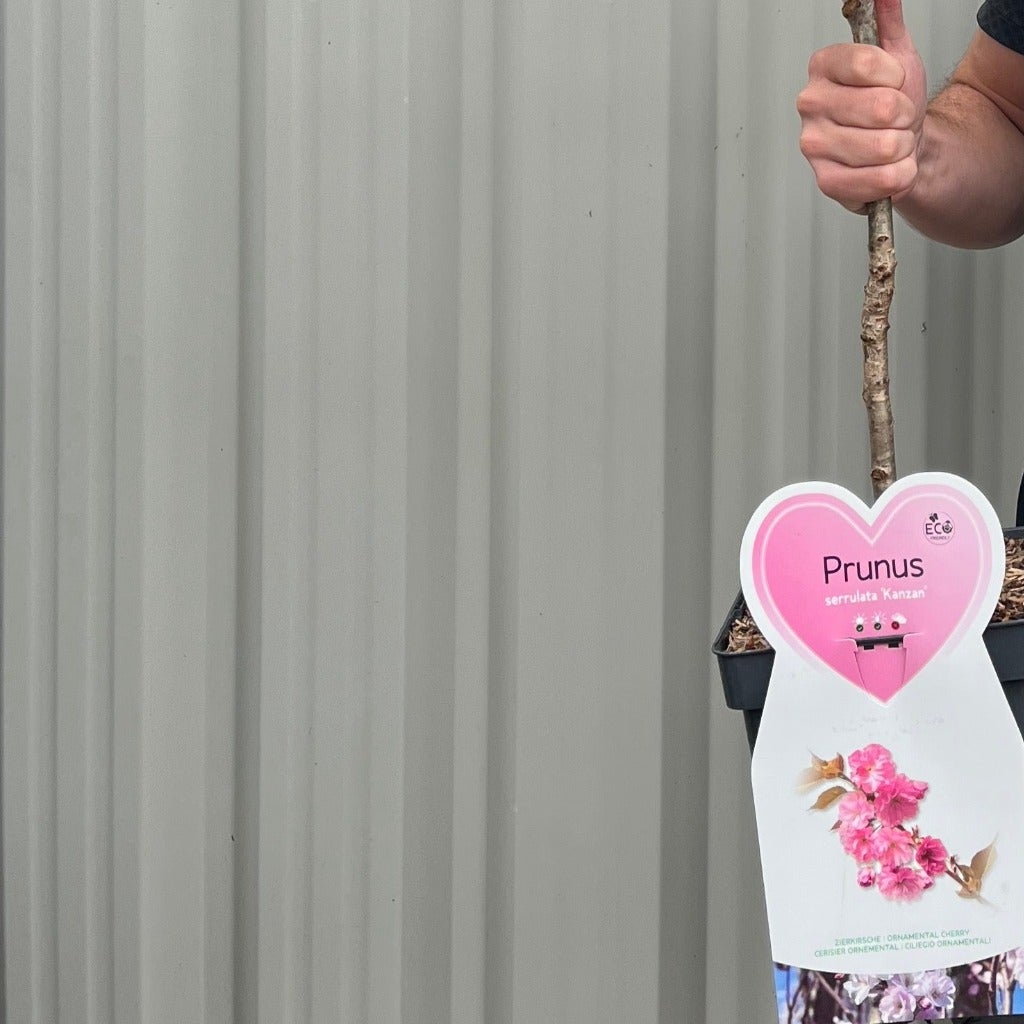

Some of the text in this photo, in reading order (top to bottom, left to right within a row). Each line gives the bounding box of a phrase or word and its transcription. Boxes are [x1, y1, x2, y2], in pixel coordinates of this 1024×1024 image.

[925, 521, 953, 535] ECO
[823, 555, 924, 584] Prunus
[825, 590, 878, 607] serrulata
[835, 929, 970, 946] ZIERKIRSCHE ORNAMENTAL CHERRY
[814, 947, 846, 958] CERISIER
[847, 943, 899, 954] ORNEMENTAL
[905, 941, 935, 951] CILIEGIO
